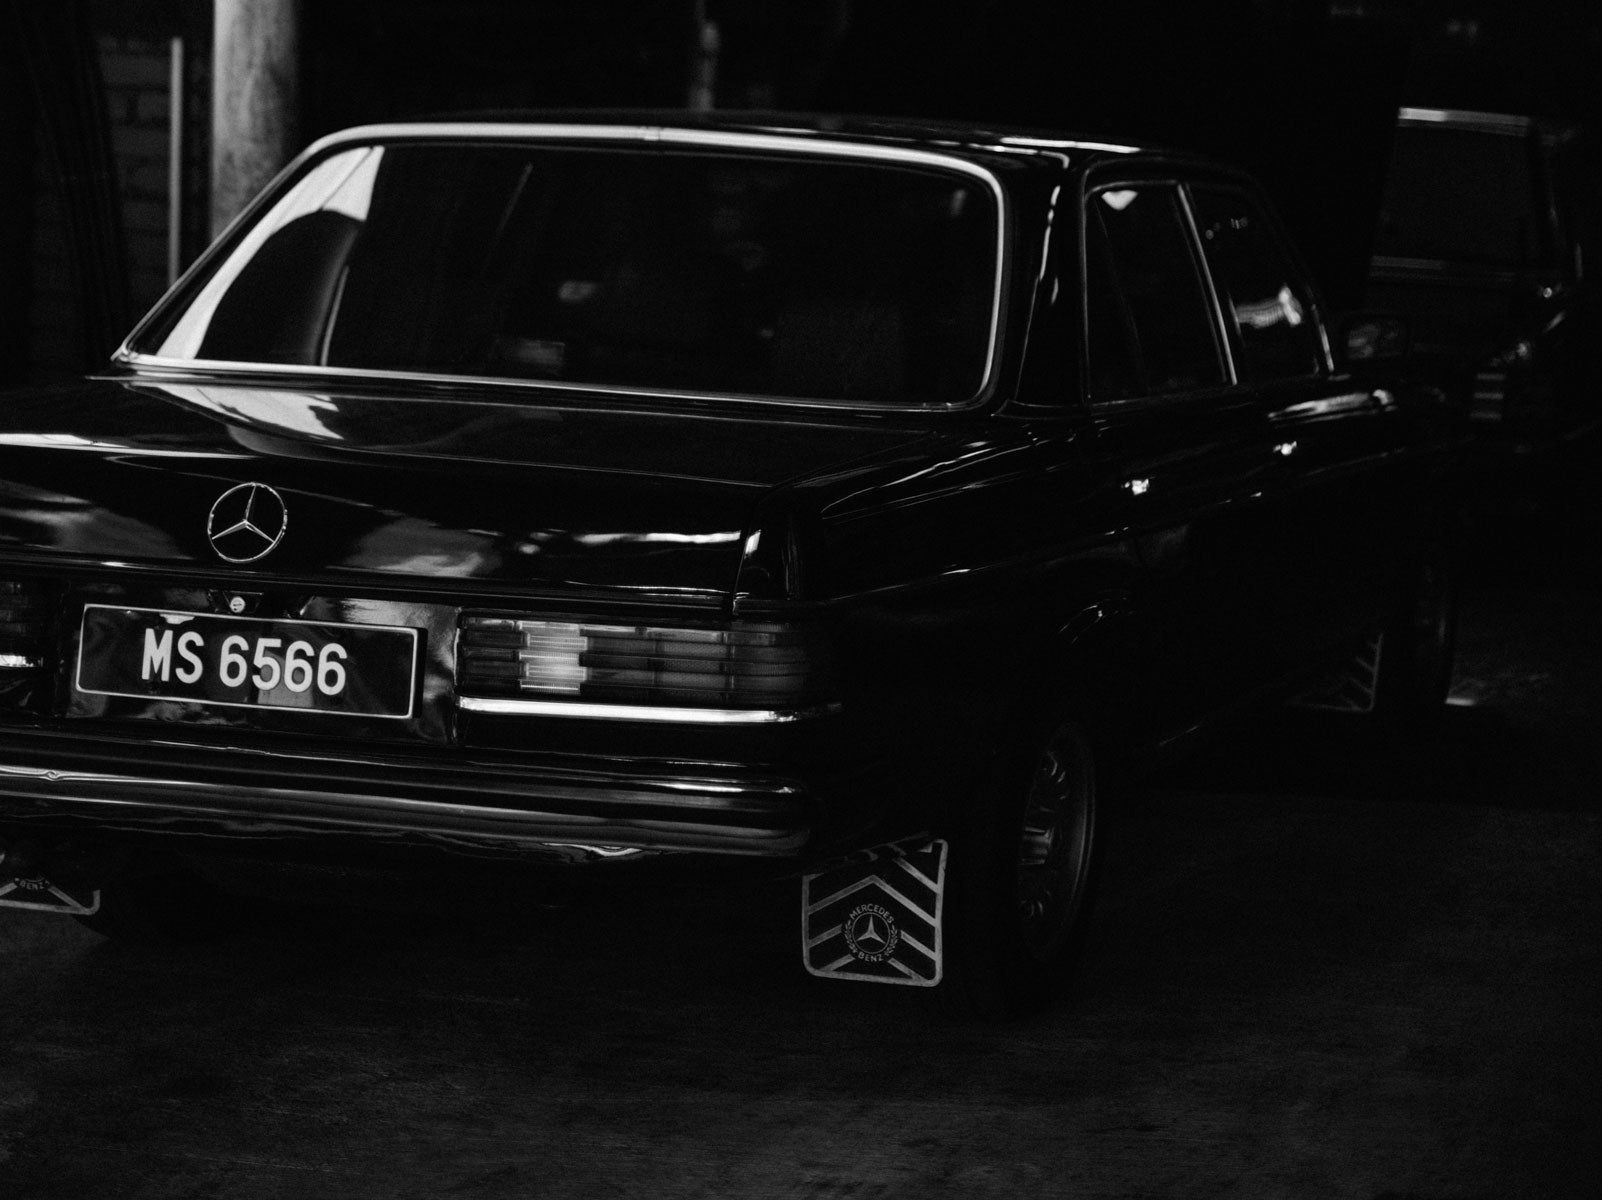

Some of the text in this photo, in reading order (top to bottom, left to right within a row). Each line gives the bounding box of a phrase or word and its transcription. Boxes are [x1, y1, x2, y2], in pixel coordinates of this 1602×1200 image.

[141, 628, 348, 696] MS 6566
[850, 903, 895, 924] MERCEDES
[857, 952, 884, 963] BENZ
